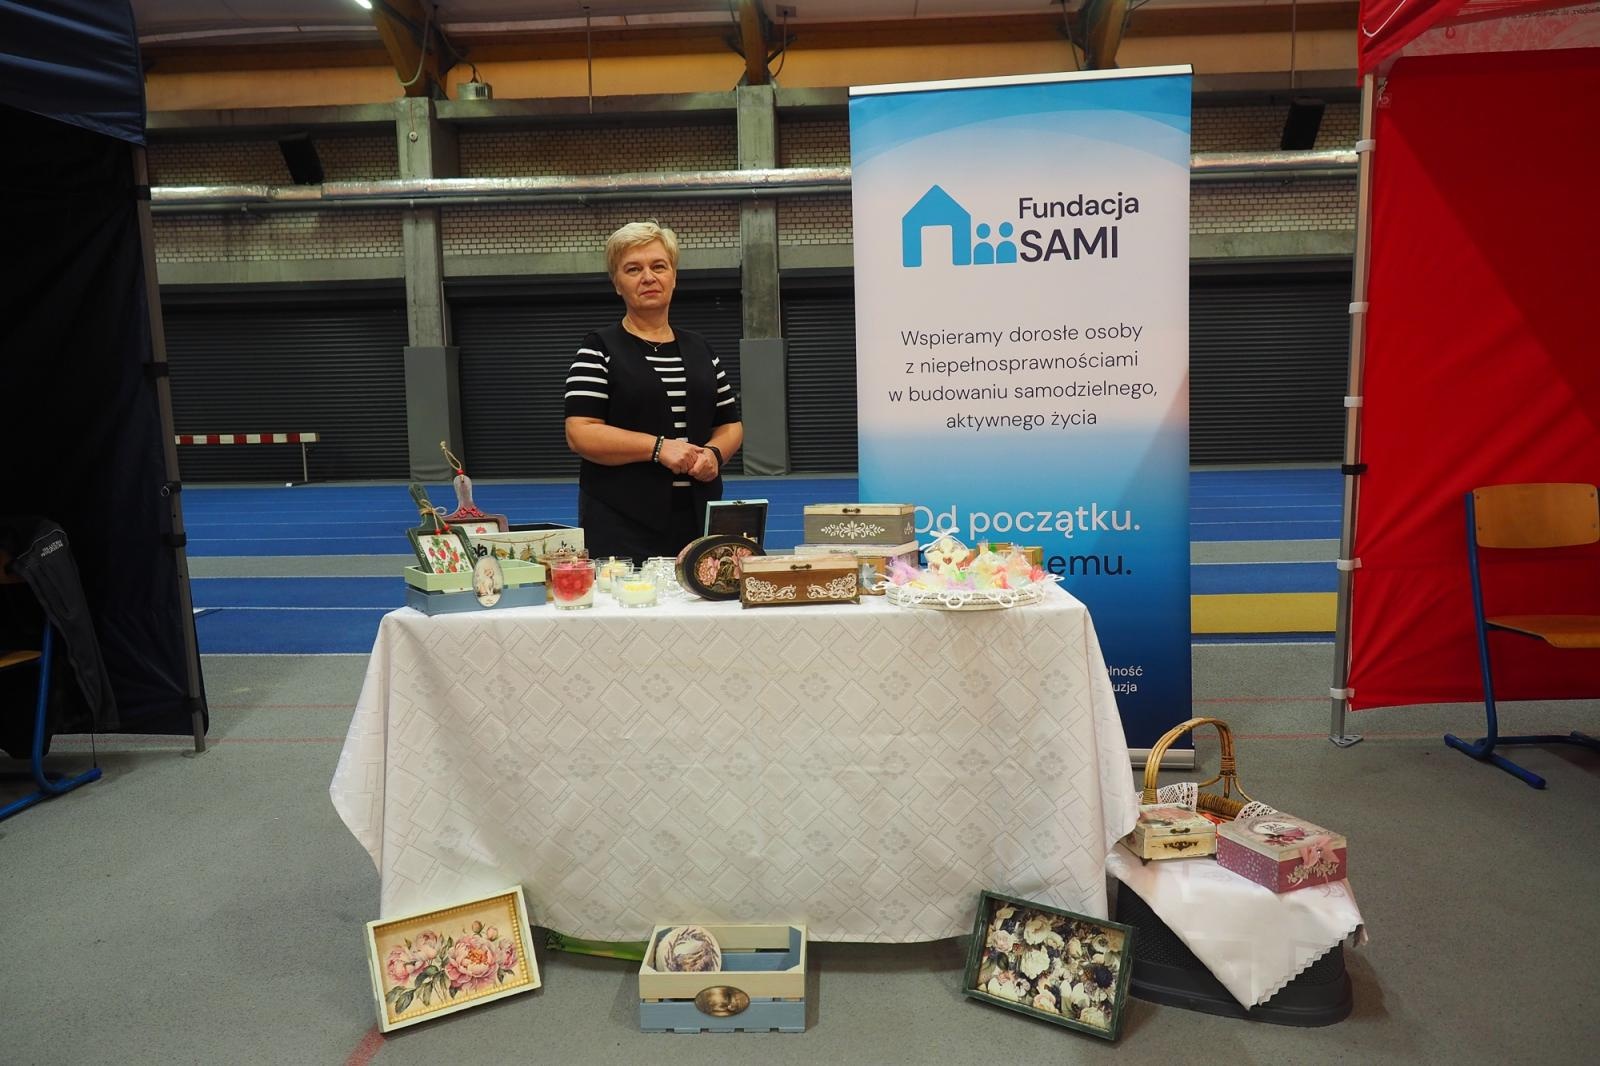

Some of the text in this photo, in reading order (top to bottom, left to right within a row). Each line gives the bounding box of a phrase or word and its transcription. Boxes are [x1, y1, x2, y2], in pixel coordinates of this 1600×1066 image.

[1019, 191, 1139, 220] Fundacja
[1020, 226, 1118, 262] SAMI
[901, 322, 1143, 349] Wspieramy dorosłe osoby
[905, 350, 1138, 376] z niepełnosprawnościami
[888, 380, 1158, 402] w budowaniu samodzielnego,
[946, 409, 1097, 432] aktywnego życia
[914, 502, 1140, 541] Od początku.
[1047, 555, 1132, 575] emu.
[1109, 665, 1143, 677] lność
[1112, 681, 1138, 694] uzja
